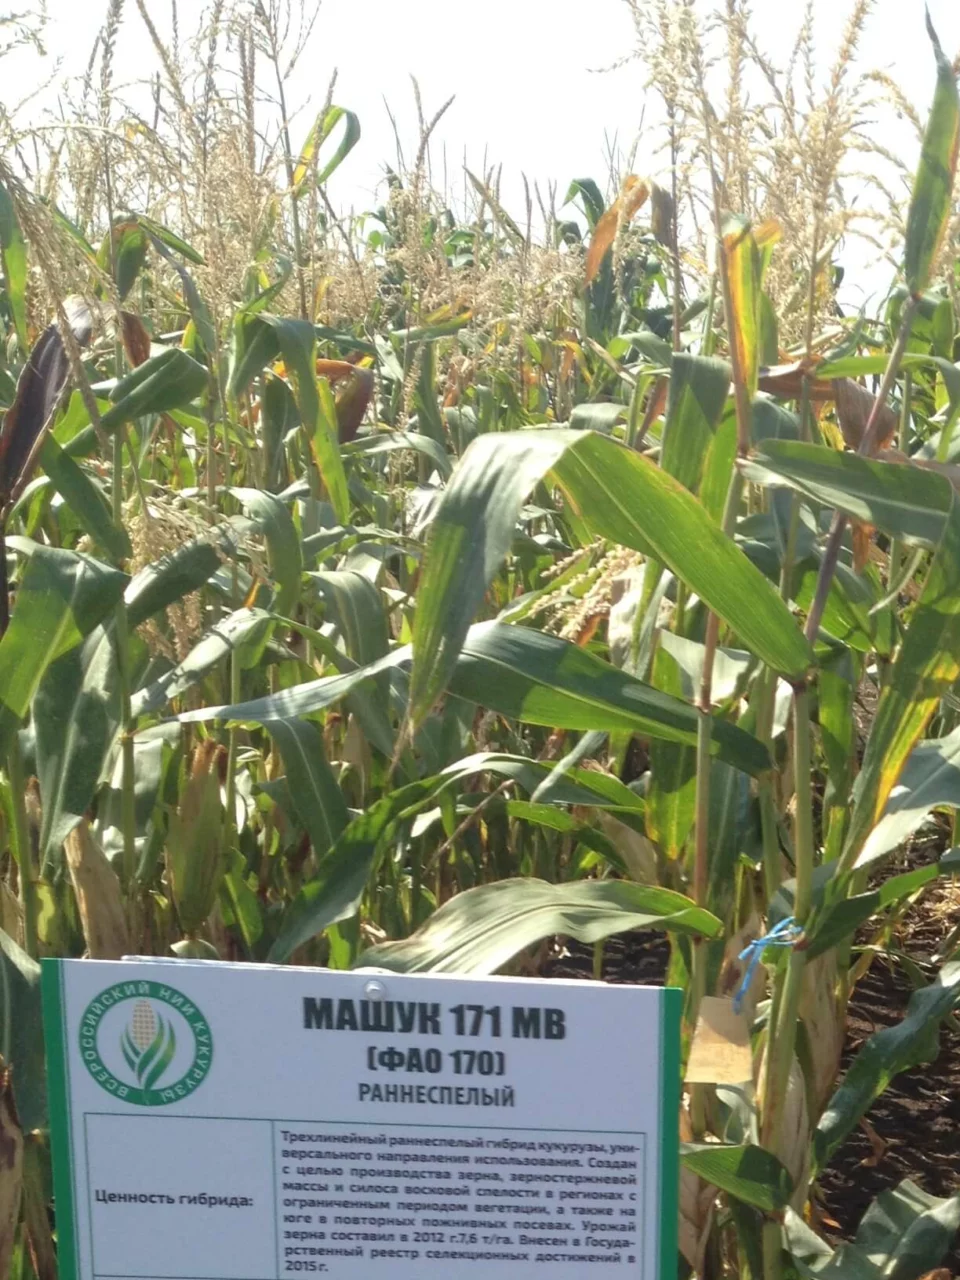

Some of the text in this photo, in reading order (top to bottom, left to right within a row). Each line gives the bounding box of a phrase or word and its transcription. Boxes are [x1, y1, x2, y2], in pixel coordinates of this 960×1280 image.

[303, 997, 567, 1040] МАШУК 171 МВ
[82, 982, 211, 1102] ВСЕРОССИЙСКИЙ НИИ КУКУРУЗЫ
[358, 1082, 515, 1107] РАННЕСПЕЛЫЙ
[281, 1130, 640, 1155] Трехлинейный раннеспелый гибрид кукурузы, уни-
[281, 1149, 637, 1170] версального направления использования. Создан
[282, 1166, 637, 1186] с целью производства зерна, зерностержневой
[95, 1189, 253, 1208] Ценность гибрида:
[282, 1182, 637, 1202] массы и силоса восковой спелости в регионах с
[283, 1198, 636, 1217] ограниченным периодом вегетации, а также на
[283, 1214, 637, 1233] юге в повторных пожнивных посевах. Урожай
[283, 1230, 326, 1242] зерна
[331, 1231, 395, 1242] составил
[400, 1233, 409, 1242] в
[413, 1231, 445, 1244] 2012
[481, 1234, 514, 1246] т/га.
[518, 1235, 568, 1247] Внесен
[572, 1237, 581, 1247] в
[585, 1236, 636, 1249] Госуда-
[284, 1246, 636, 1264] рственный реестр селекционных достижений в
